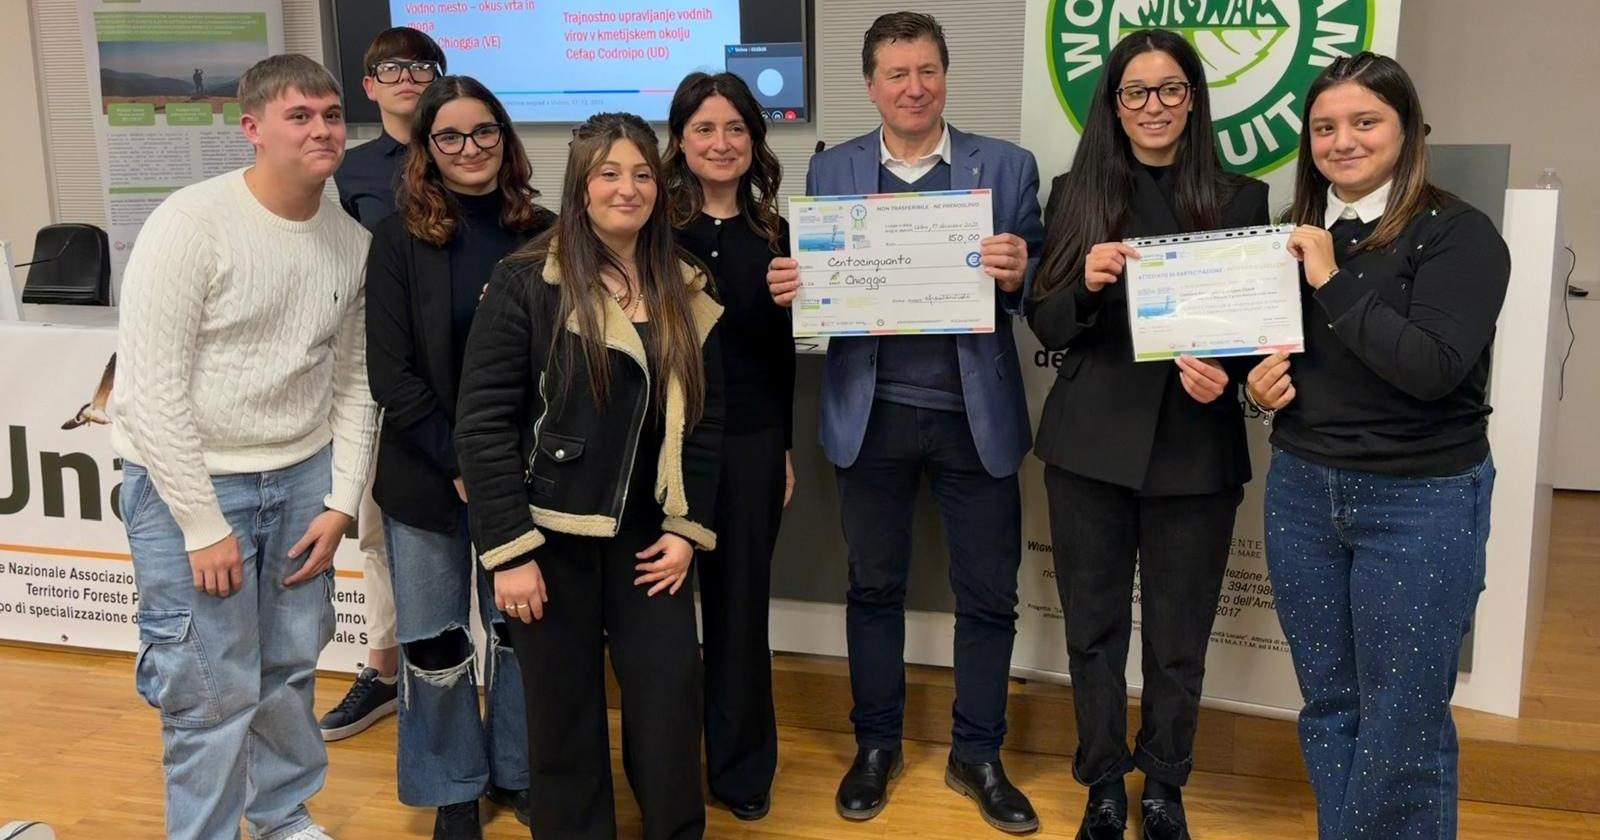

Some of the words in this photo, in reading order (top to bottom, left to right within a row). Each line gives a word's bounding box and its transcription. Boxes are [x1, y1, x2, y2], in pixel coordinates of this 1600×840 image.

[405, 3, 436, 14] Vodno
[438, 2, 468, 13] mesto
[479, 1, 501, 11] okus
[504, 1, 524, 11] vrta
[526, 0, 535, 10] in
[563, 11, 616, 25] Trajnostno
[618, 9, 676, 24] upravljanje
[678, 8, 713, 20] vodnih
[438, 37, 480, 50] Chioggia
[482, 36, 501, 49] (VE)
[564, 30, 588, 42] virov
[590, 32, 596, 40] v
[597, 28, 657, 43] kmetijskem
[659, 26, 690, 42] okolju
[566, 48, 595, 61] Cefap
[598, 47, 644, 60] Codroipo
[647, 46, 669, 59] (UD)
[828, 254, 912, 272] Centocinquanta
[8, 561, 66, 579] Nazionale
[70, 567, 134, 585] Associazio
[26, 583, 80, 599] Territorio
[83, 588, 128, 605] Foreste
[15, 602, 26, 614] di
[29, 604, 128, 624] specializzazione
[1216, 606, 1241, 618] 2017
